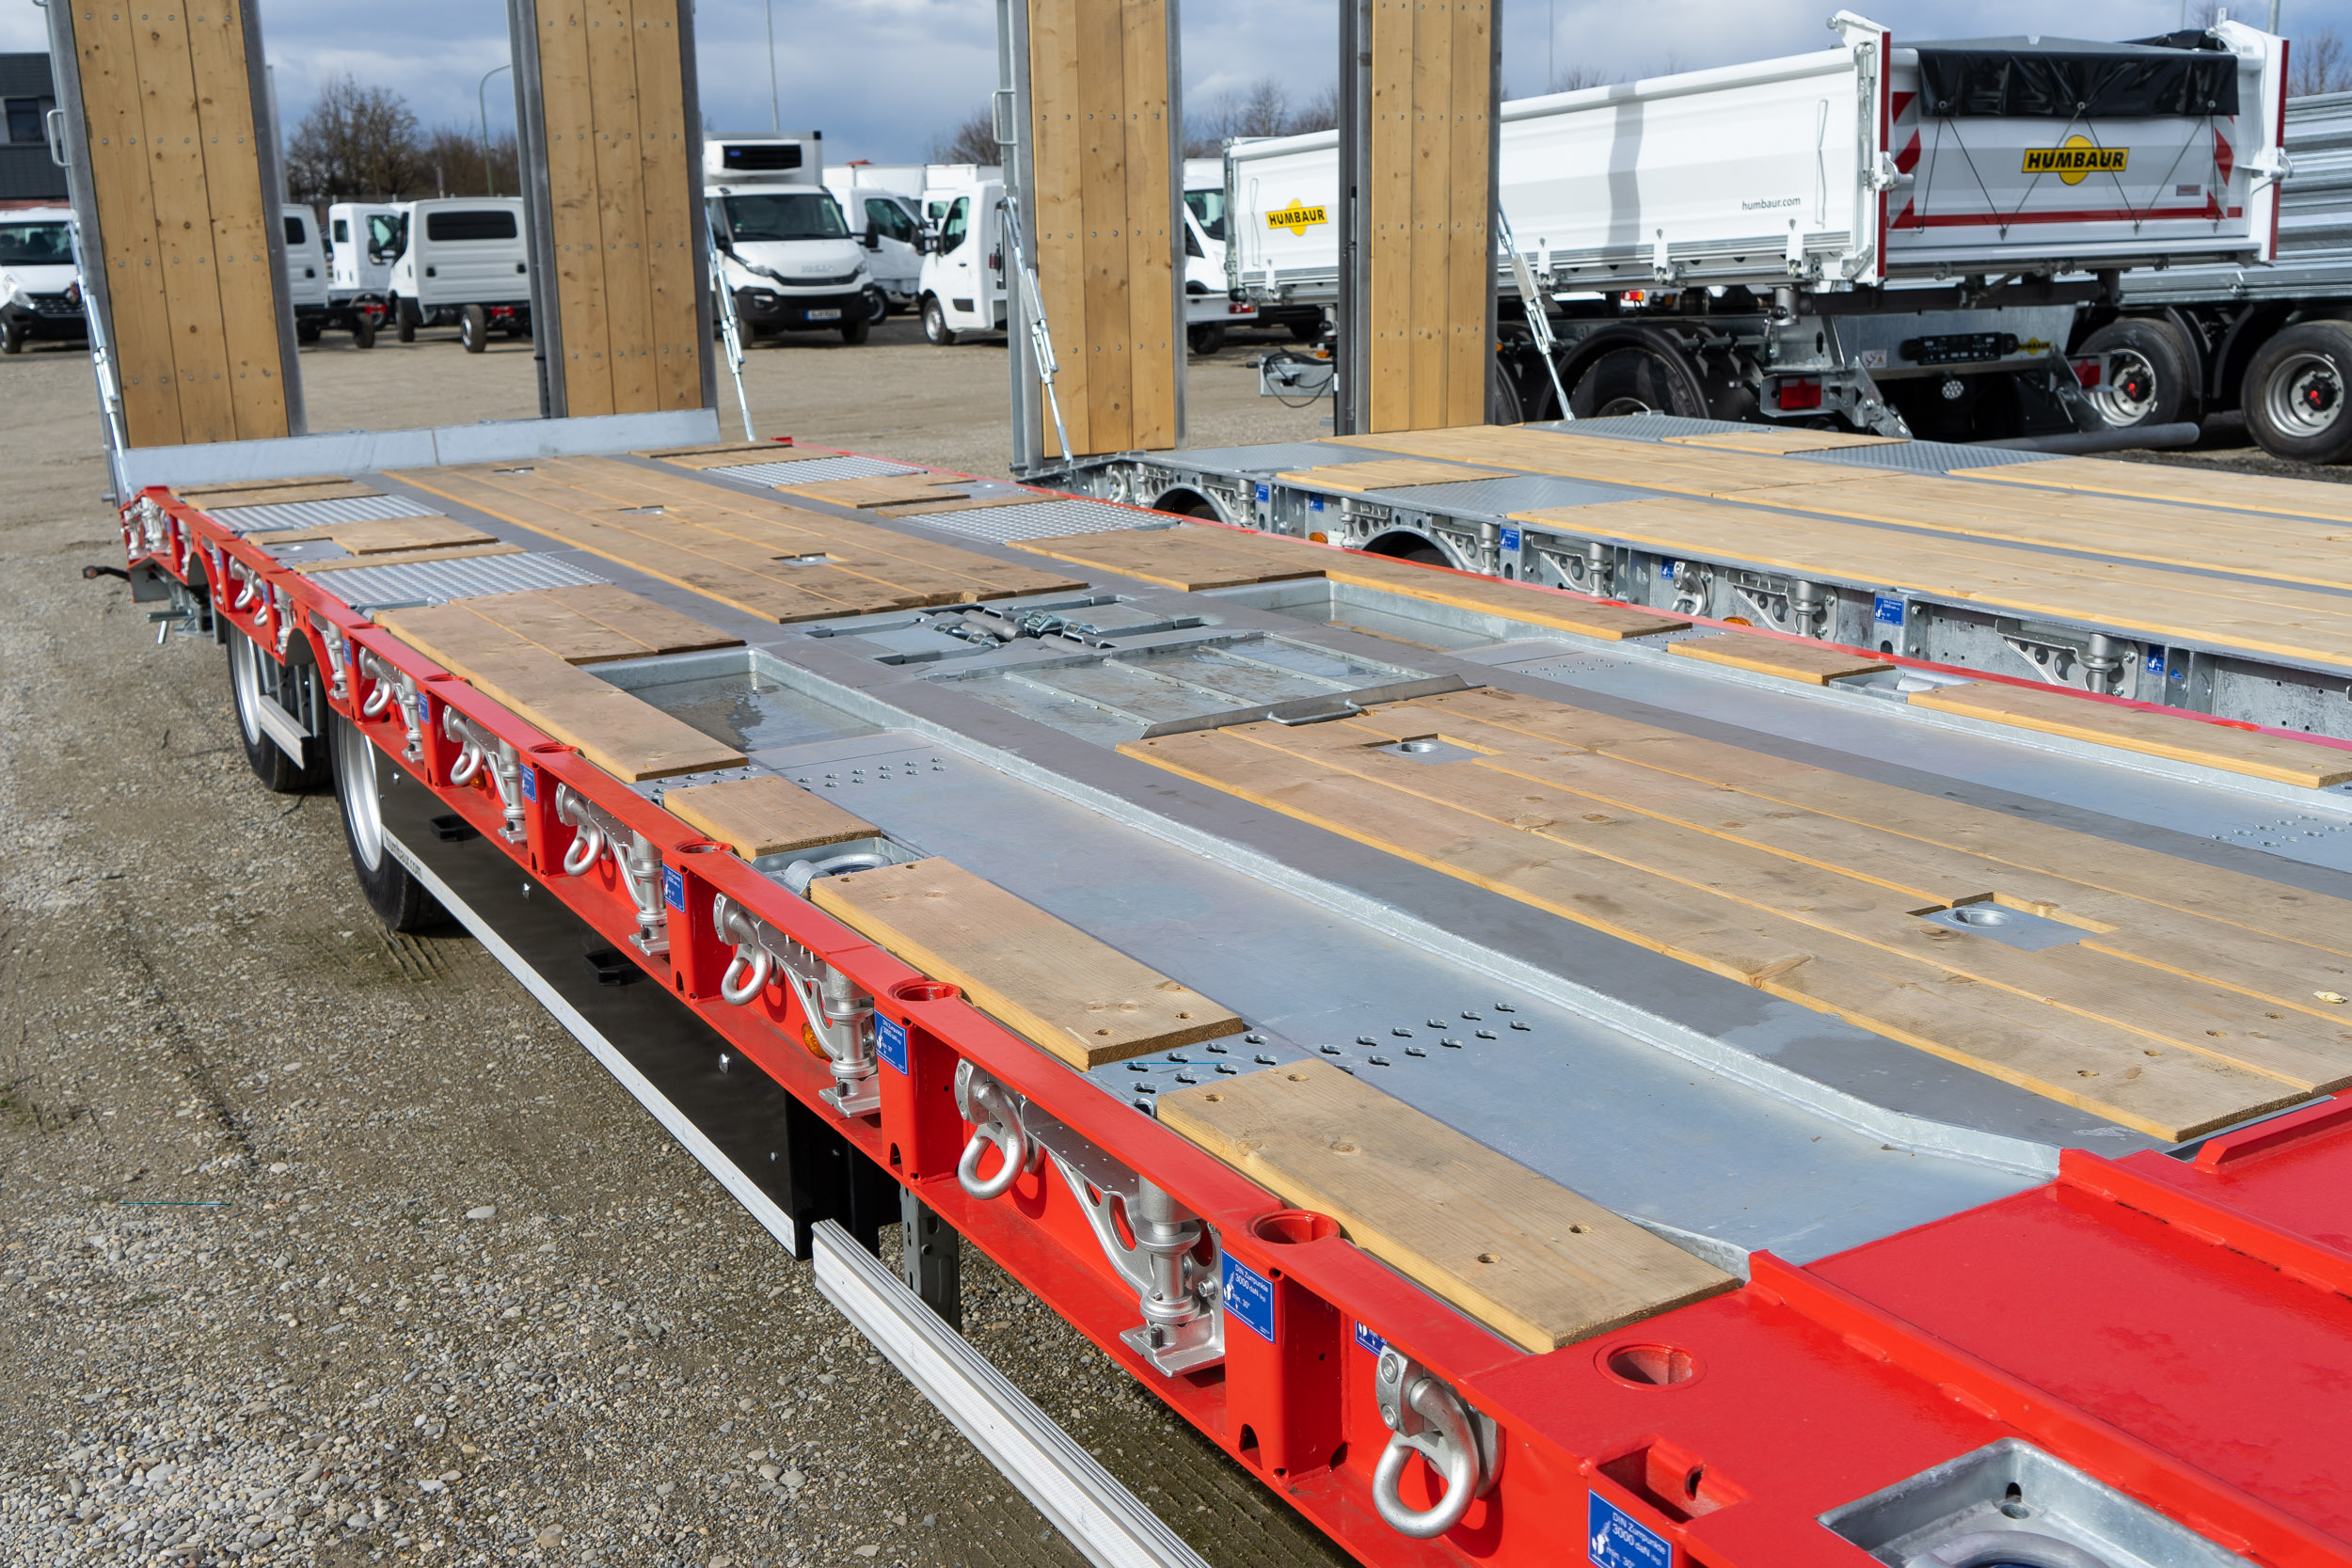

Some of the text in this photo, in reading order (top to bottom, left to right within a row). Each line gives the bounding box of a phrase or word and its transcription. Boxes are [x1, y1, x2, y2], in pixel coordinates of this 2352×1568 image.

[2027, 150, 2124, 168] HUMBAUR
[1741, 198, 1802, 211] humbaur.com
[1268, 209, 1325, 226] HUMBAUR
[1234, 1263, 1269, 1293] DIN Zurrpunkte
[1234, 1273, 1249, 1290] 3000
[1248, 1286, 1259, 1297] daN
[1612, 1512, 1666, 1555] DIN Zurrpunkte
[1612, 1523, 1634, 1546] 3000
[1634, 1543, 1651, 1558] daN
[1606, 1546, 1622, 1562] min.
